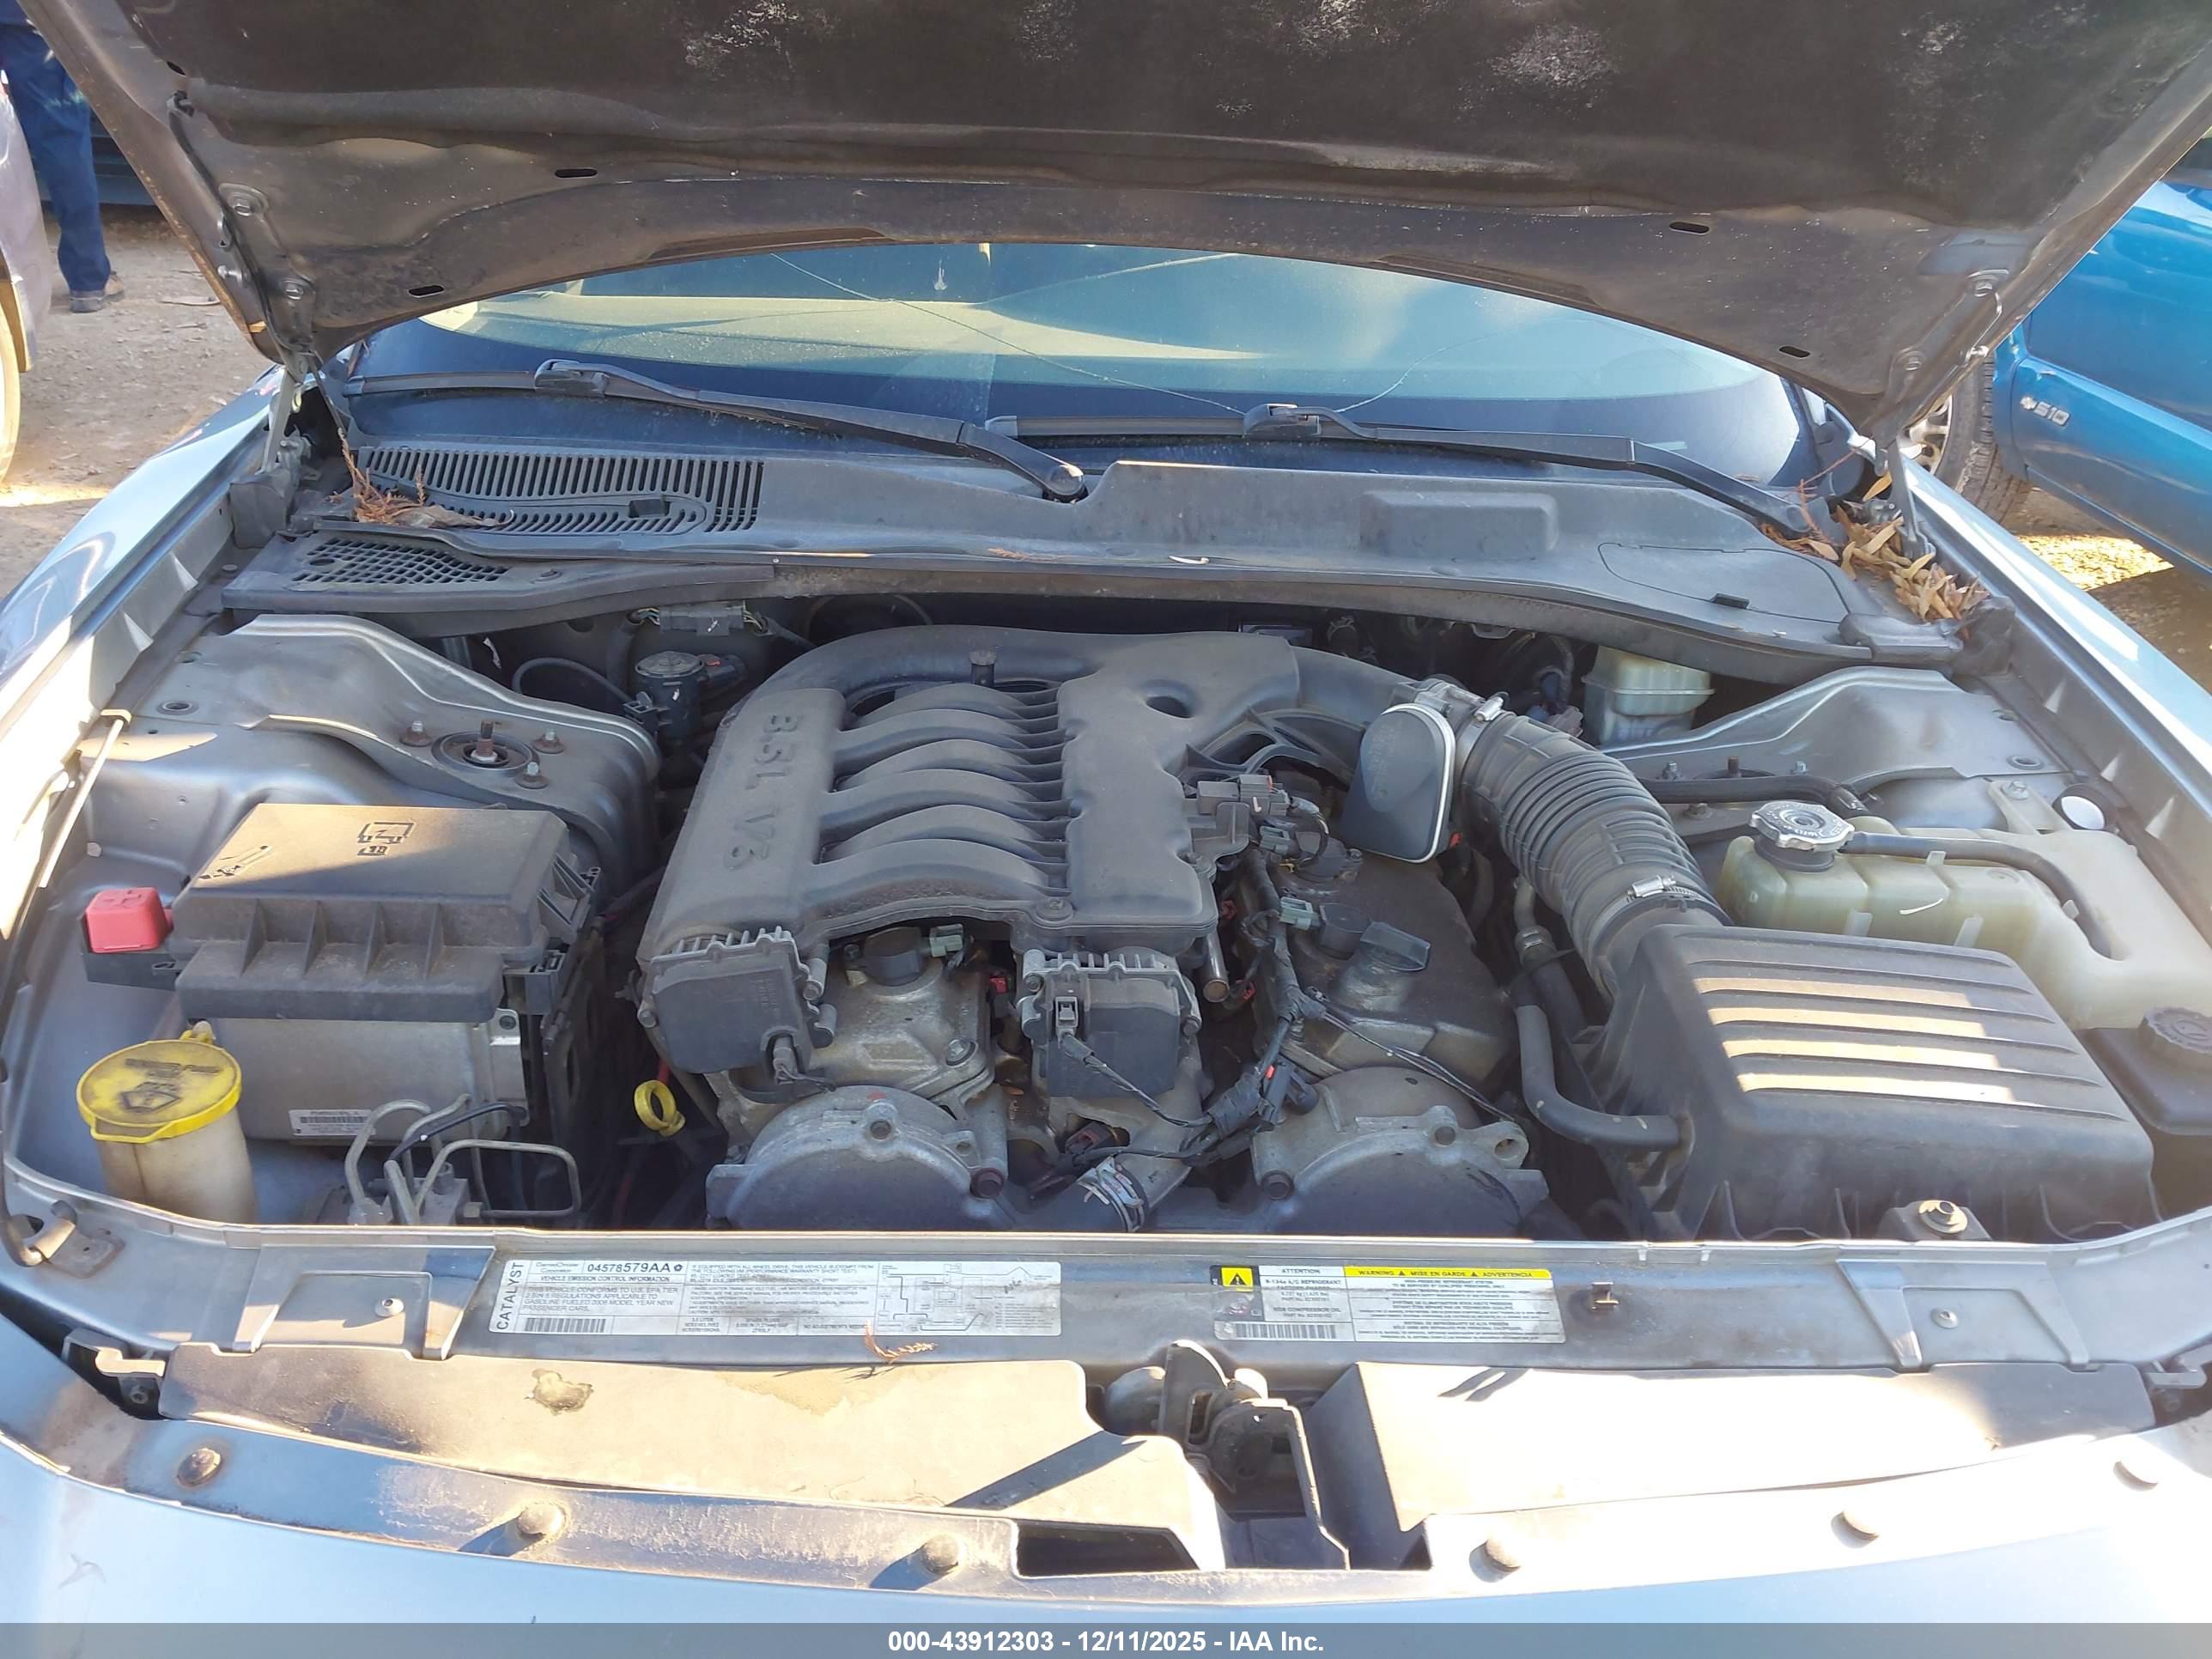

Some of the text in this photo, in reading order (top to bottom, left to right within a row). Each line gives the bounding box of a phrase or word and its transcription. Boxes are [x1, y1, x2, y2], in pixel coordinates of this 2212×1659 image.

[724, 808, 779, 872] V6
[496, 1262, 524, 1330] CATALYST
[587, 1263, 672, 1273] 04578579AA
